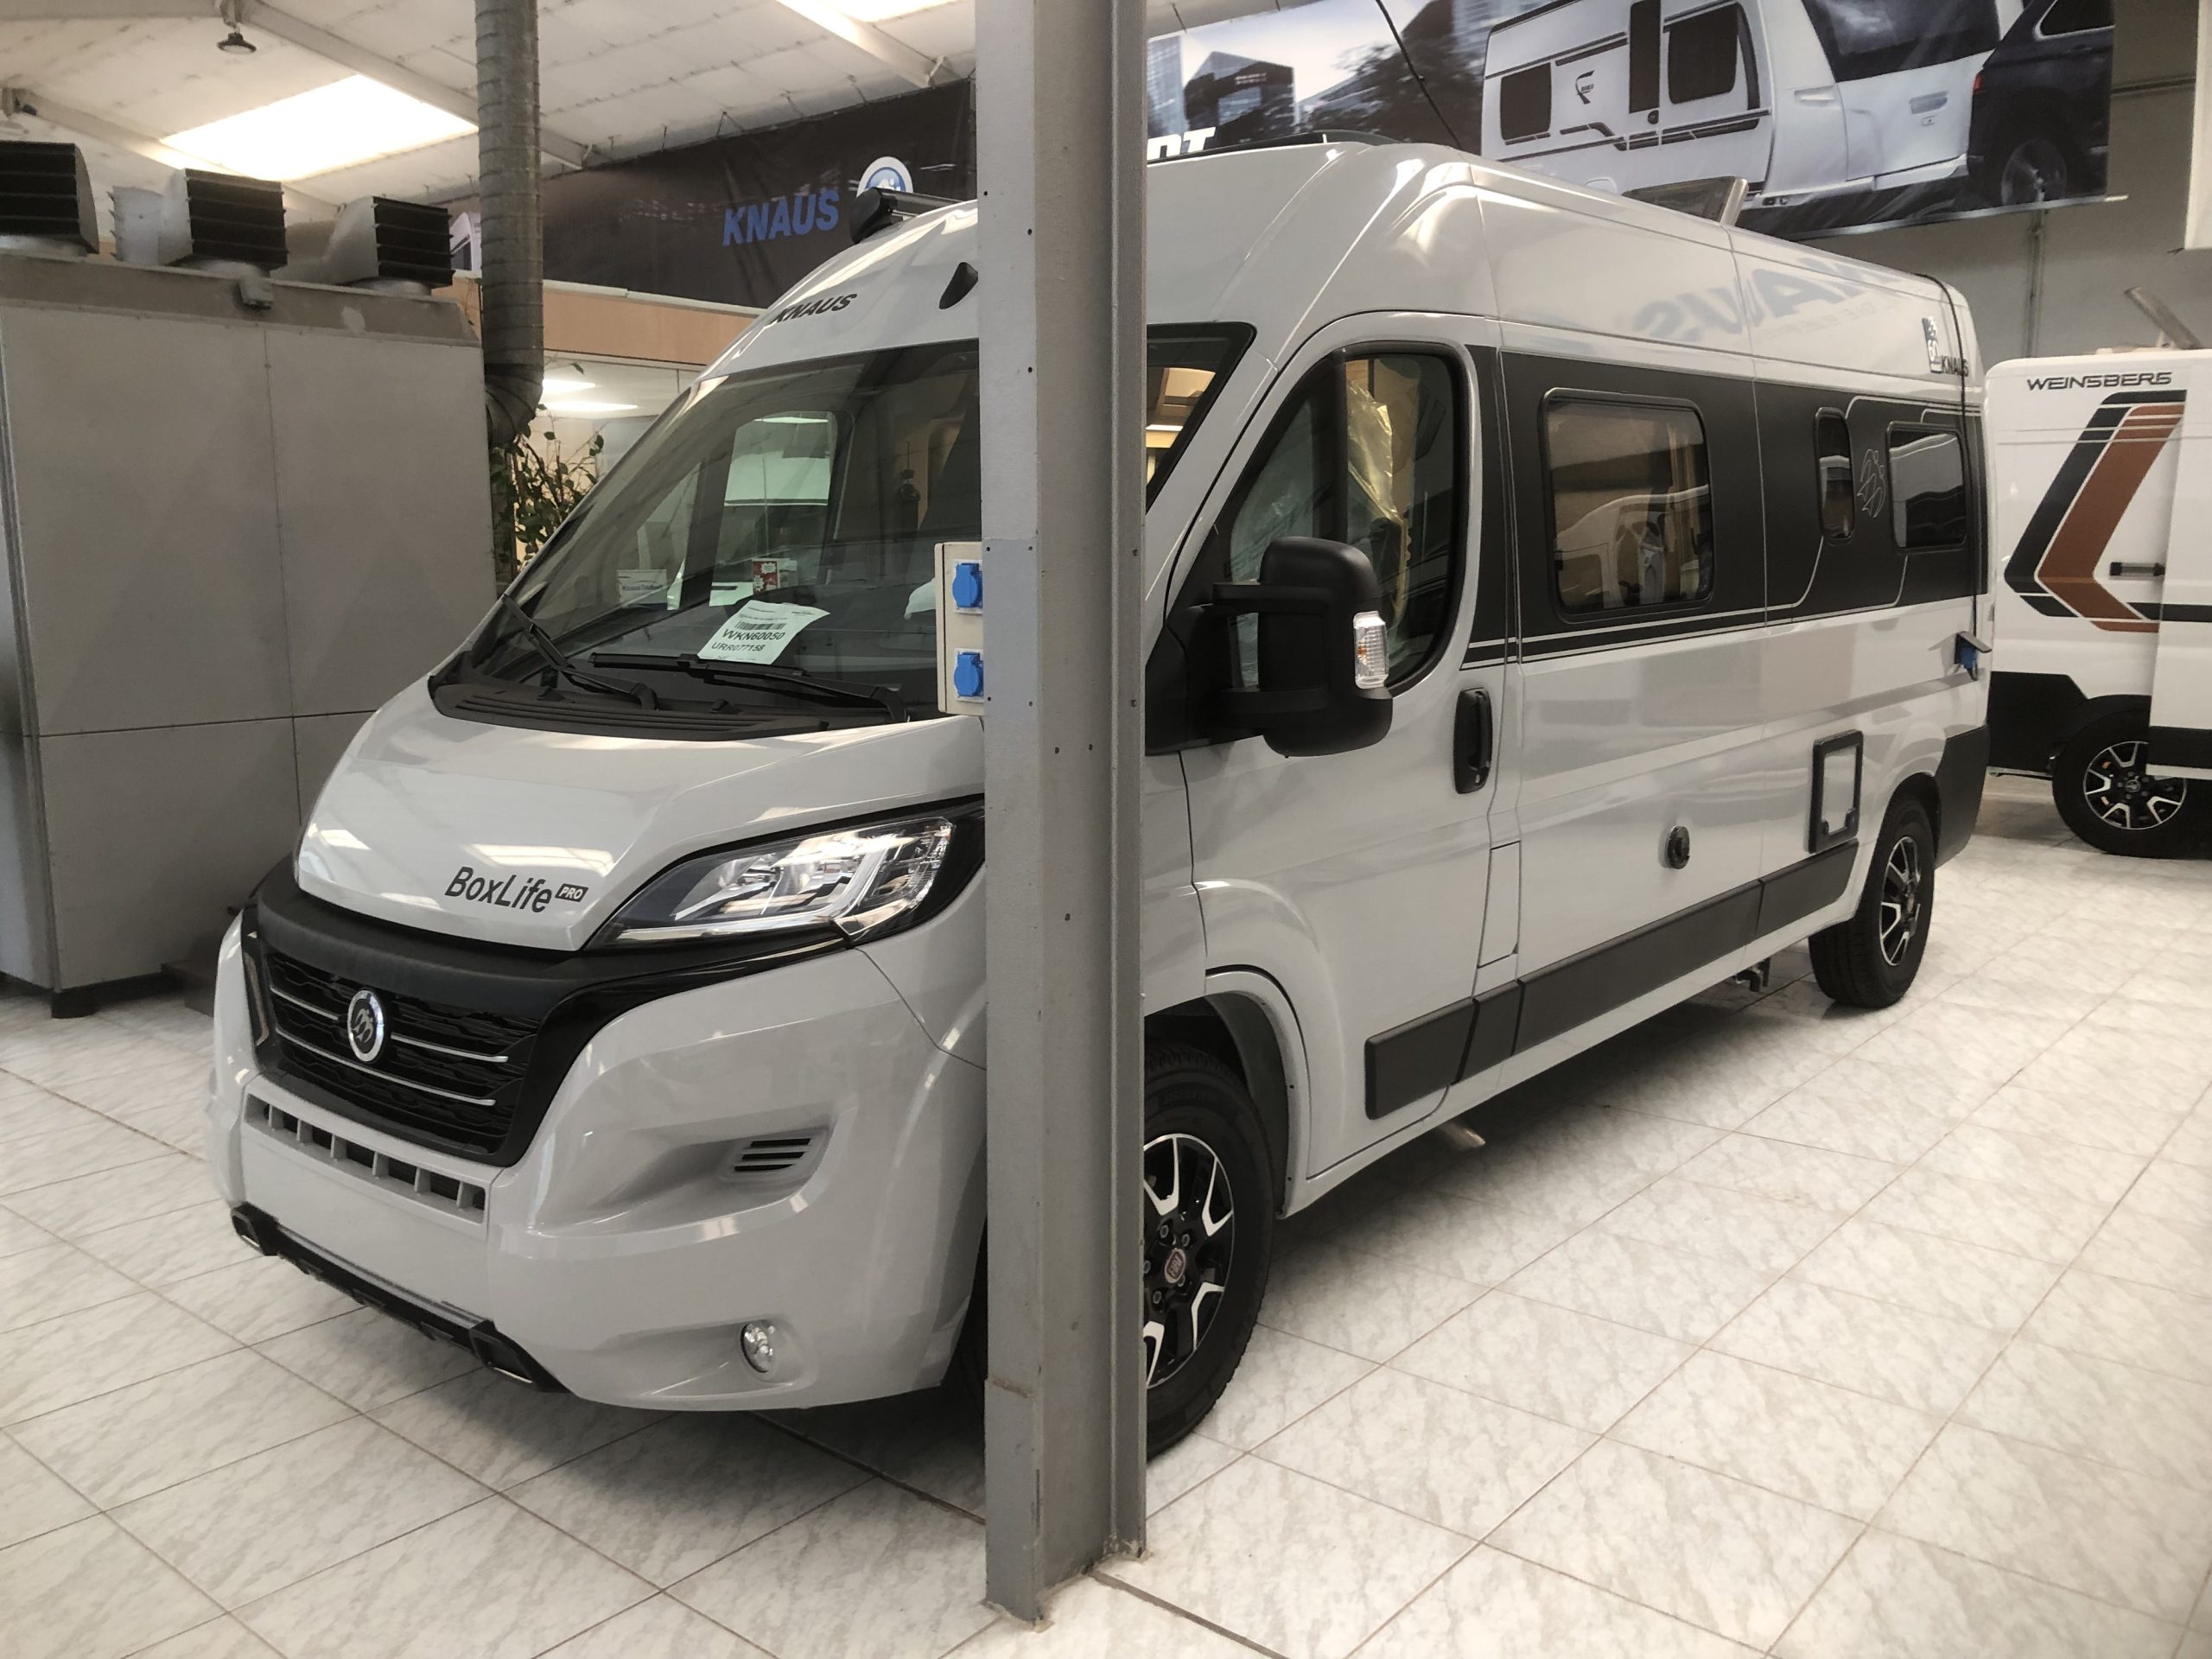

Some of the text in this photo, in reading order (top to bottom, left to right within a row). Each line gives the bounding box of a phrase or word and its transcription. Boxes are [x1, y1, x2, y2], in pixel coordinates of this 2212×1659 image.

[722, 187, 840, 246] KNAUS
[770, 293, 858, 324] KNAUS
[2027, 372, 2172, 391] WEINSBERG
[722, 629, 786, 641] WKN60050
[444, 866, 585, 913] BoxLife PRO
